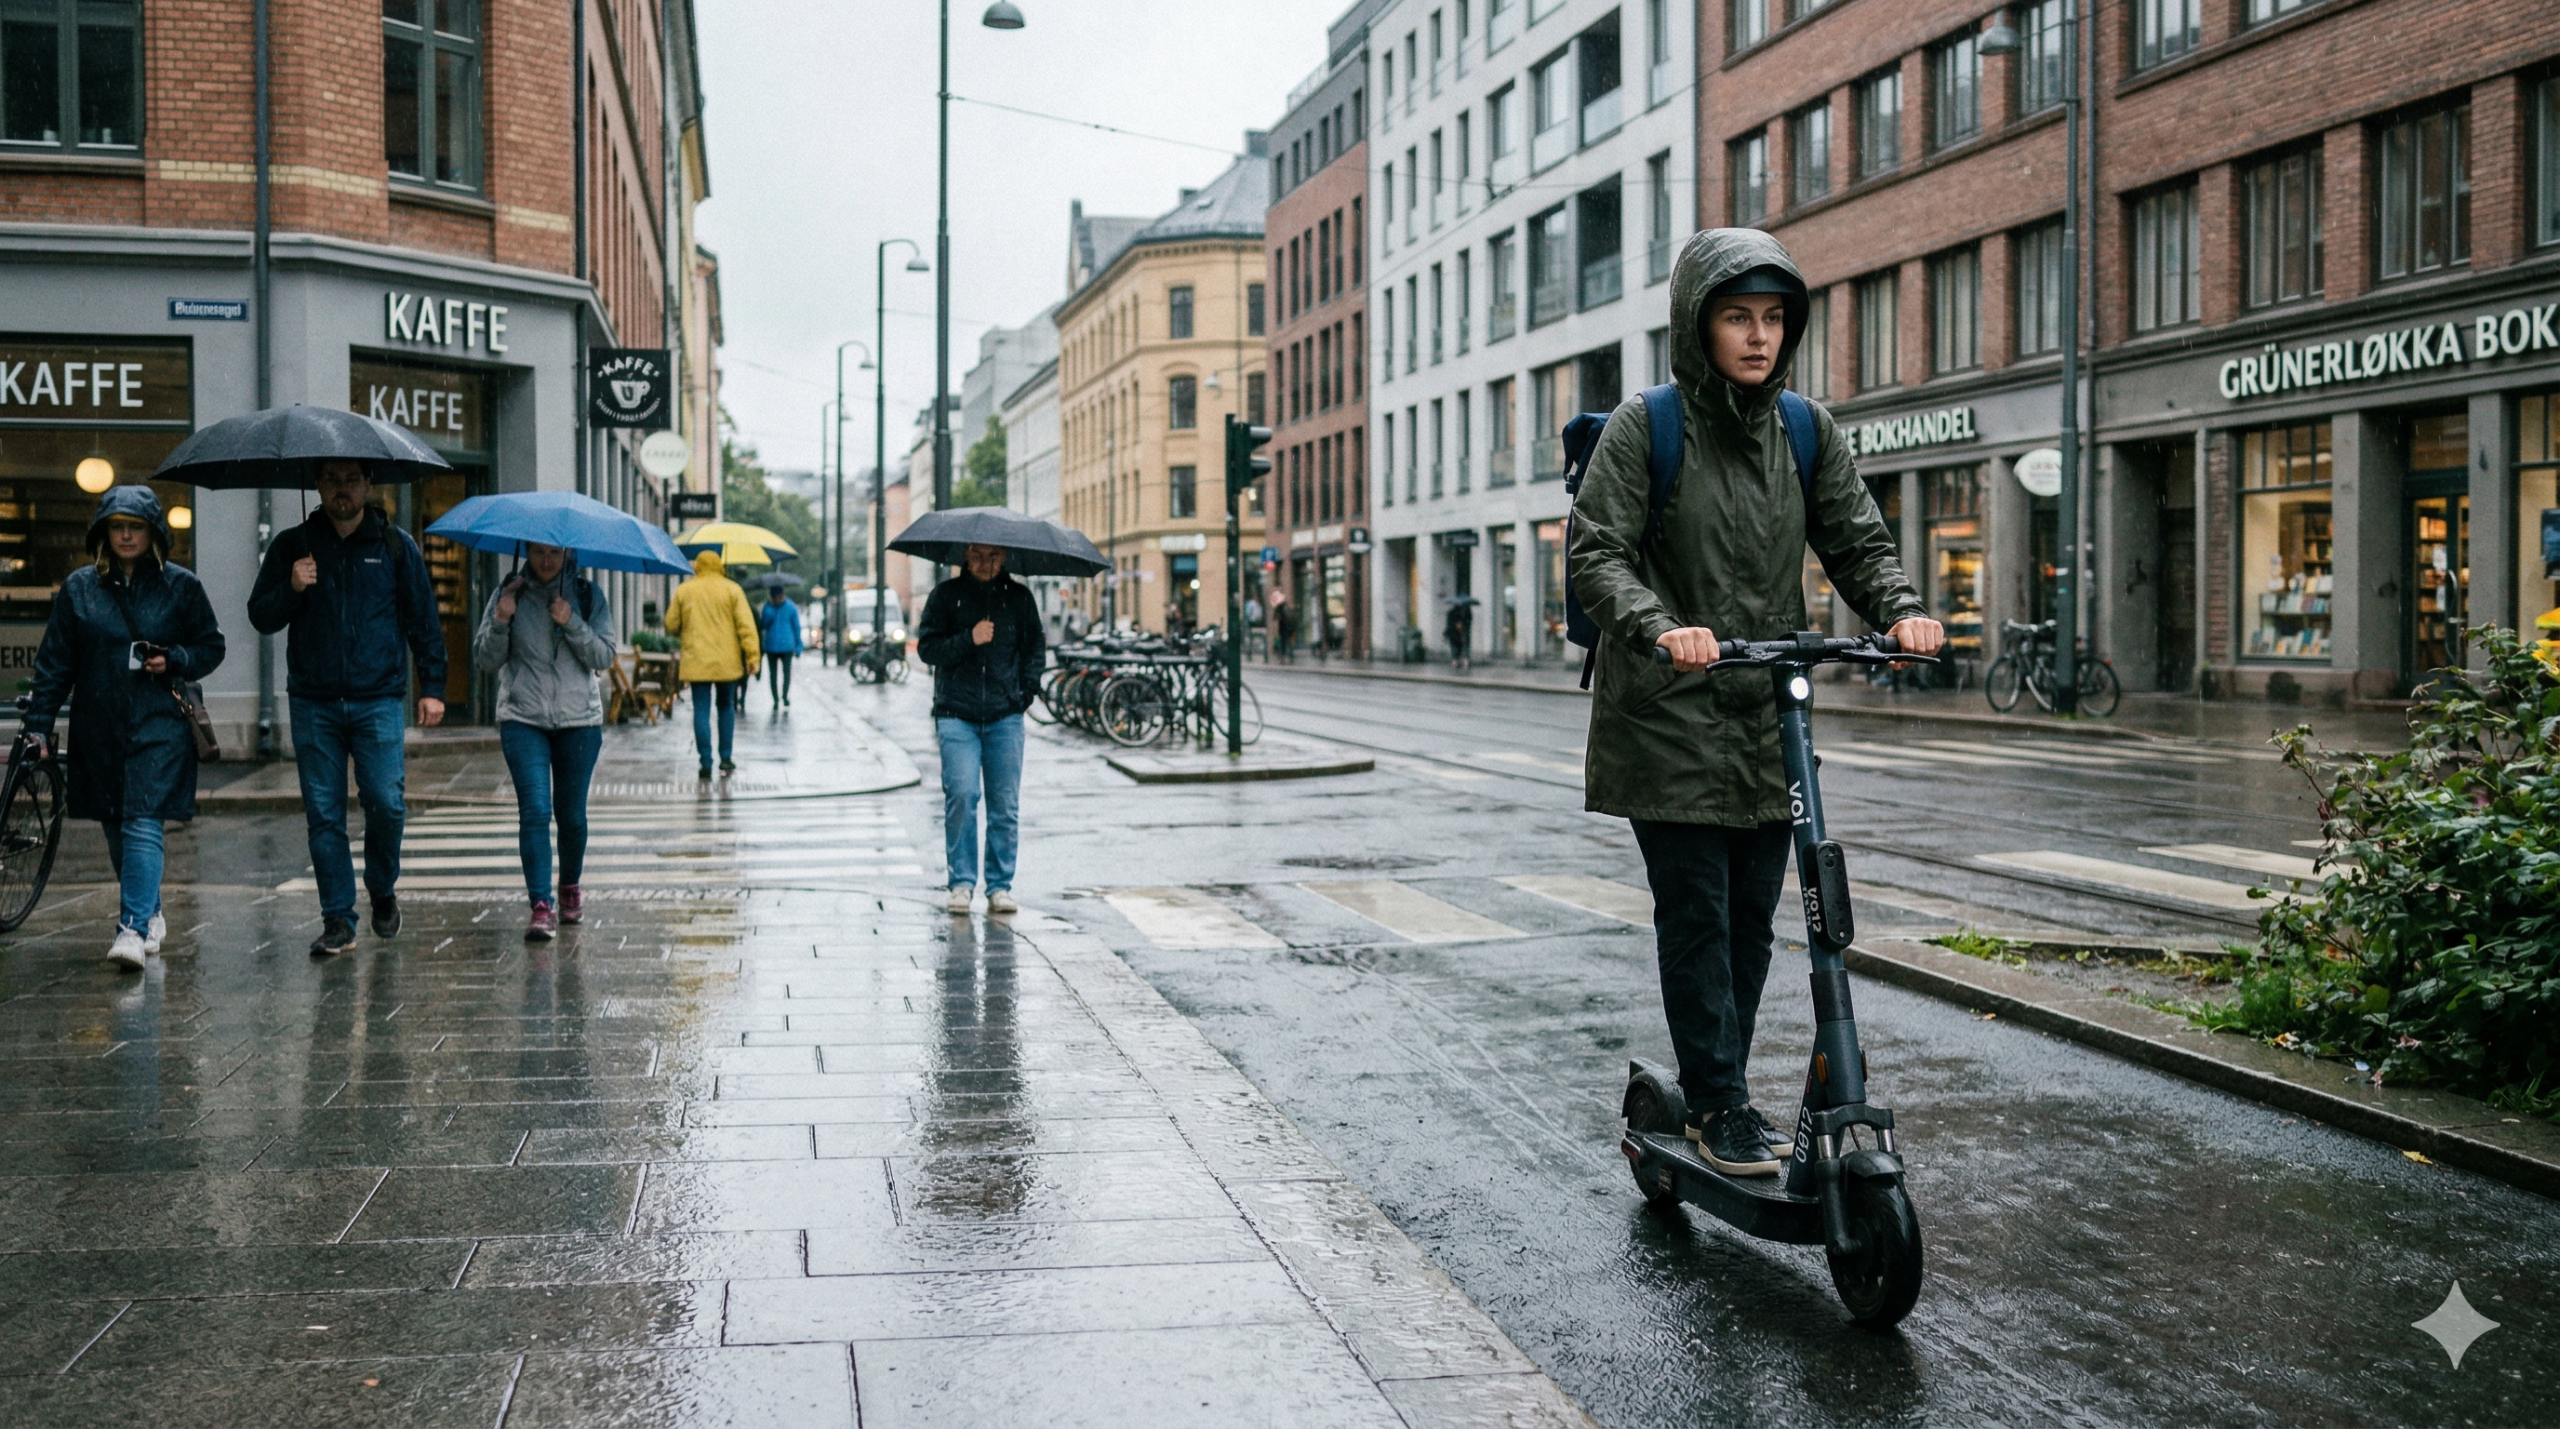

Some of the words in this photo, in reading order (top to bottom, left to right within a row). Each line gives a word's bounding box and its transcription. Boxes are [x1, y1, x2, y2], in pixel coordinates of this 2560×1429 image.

[388, 292, 509, 352] KAFFE
[602, 356, 655, 377] KAFFE
[2219, 321, 2463, 399] GRÜNERLØKKA
[0, 361, 144, 407] KAFFE
[370, 384, 464, 430] KAFFE
[1861, 406, 1975, 455] BOKHANDEL
[1788, 780, 1812, 826] voi
